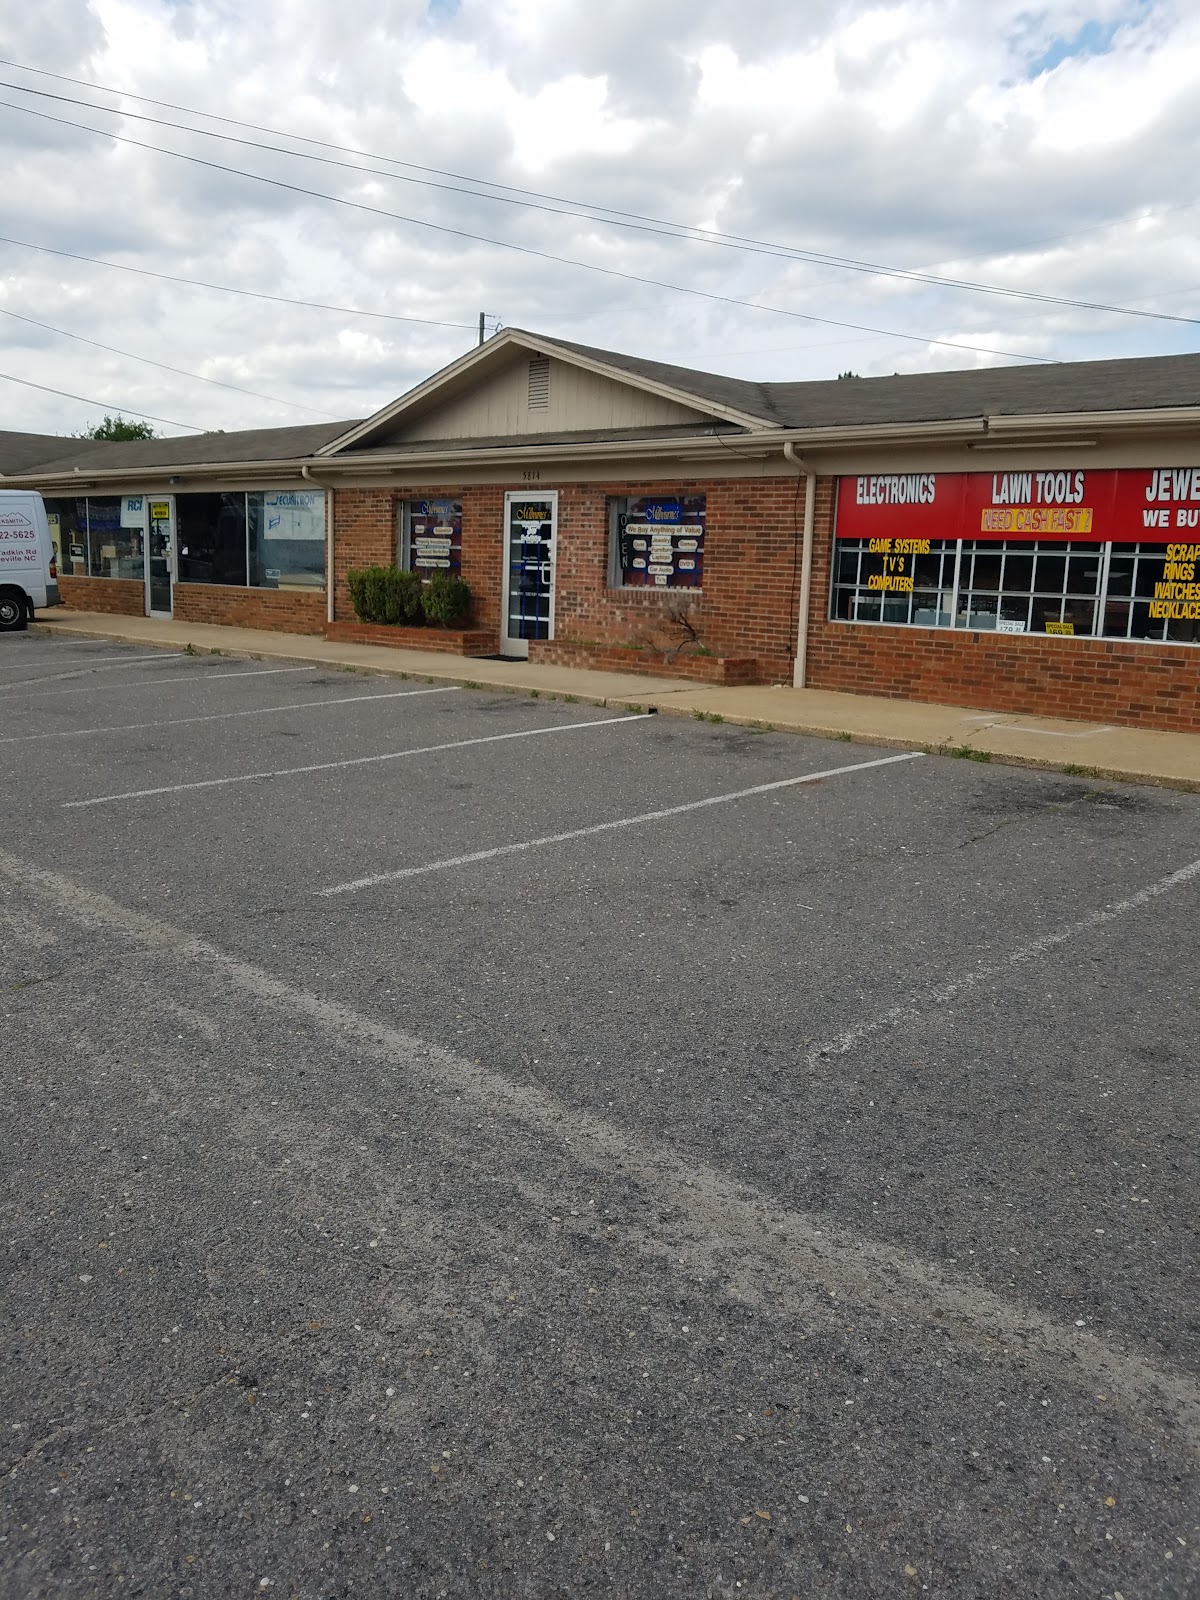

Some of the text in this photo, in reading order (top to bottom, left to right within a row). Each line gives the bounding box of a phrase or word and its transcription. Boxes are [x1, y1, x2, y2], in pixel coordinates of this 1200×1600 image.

[523, 471, 541, 480] 5814
[856, 474, 936, 505] ELECTRONICS
[991, 470, 1085, 504] LAWN TOOLS
[984, 509, 1013, 530] NEED
[1017, 509, 1050, 531] CASH
[1052, 509, 1083, 532] FAST
[1143, 508, 1200, 528] WE BU
[638, 526, 649, 534] Buy
[649, 526, 675, 534] Anything
[684, 526, 701, 534] Value
[868, 538, 931, 555] GAME SYSTEMS
[1165, 543, 1200, 562] SCRAP
[1162, 562, 1196, 581] RINGS
[867, 575, 914, 592] COMPUTERS
[1154, 581, 1200, 600] WATCHES
[1148, 601, 1200, 620] NECKLACE
